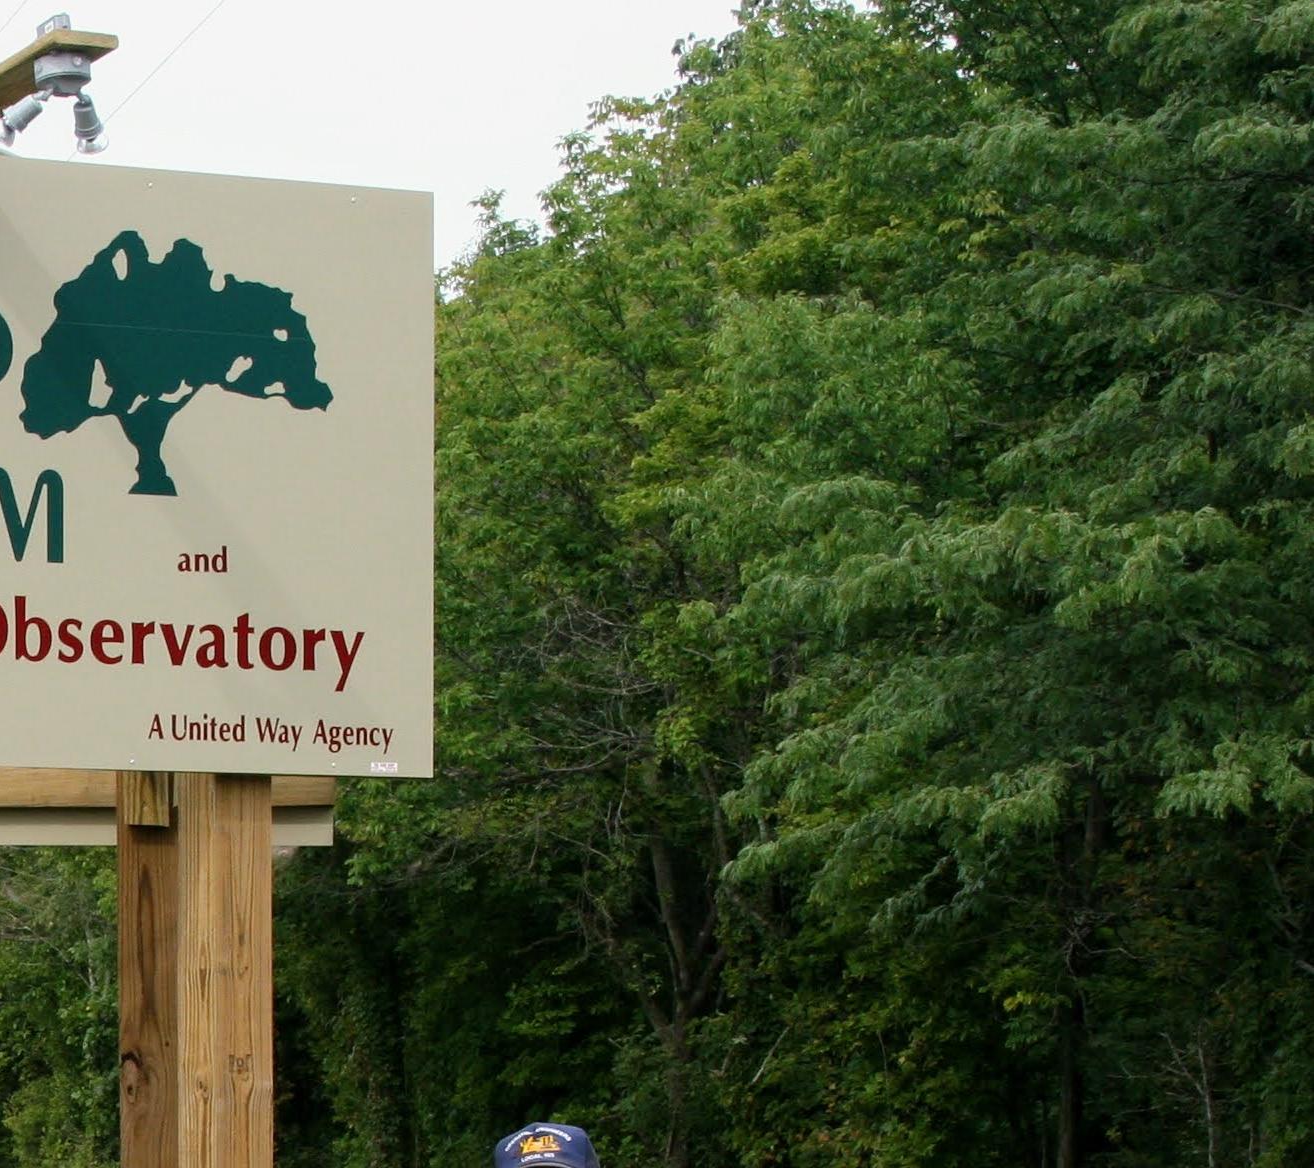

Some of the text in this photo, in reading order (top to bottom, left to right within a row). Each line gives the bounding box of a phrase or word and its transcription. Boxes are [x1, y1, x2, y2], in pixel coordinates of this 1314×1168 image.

[177, 546, 228, 574] and
[149, 713, 394, 754] A United Way Agency
